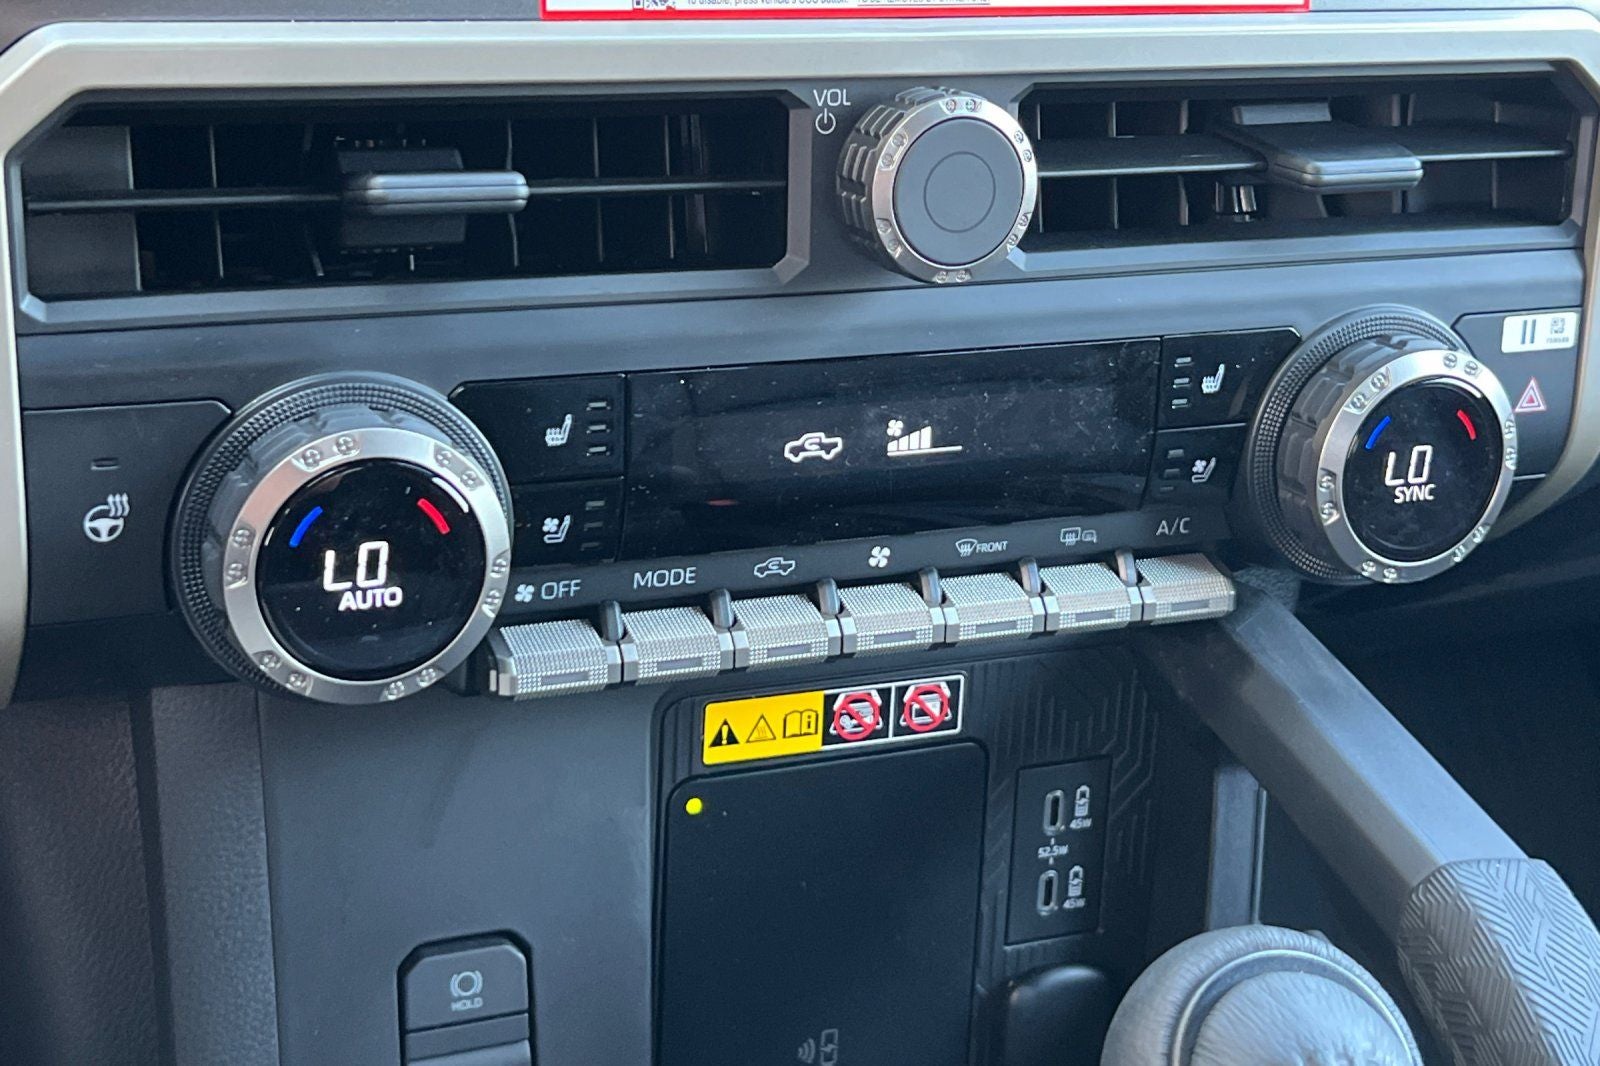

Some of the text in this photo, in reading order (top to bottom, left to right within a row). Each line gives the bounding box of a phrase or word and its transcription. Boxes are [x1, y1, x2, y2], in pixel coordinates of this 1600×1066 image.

[813, 88, 851, 107] VOL
[1393, 483, 1437, 504] SYNC
[1155, 516, 1191, 537] A/C
[974, 540, 1008, 554] FRONT
[632, 566, 697, 590] MODE
[337, 585, 403, 612] AUTO
[540, 579, 582, 601] OFF
[1069, 818, 1093, 830] 45W
[1062, 897, 1086, 909] 45W
[450, 997, 484, 1011] HOLD
